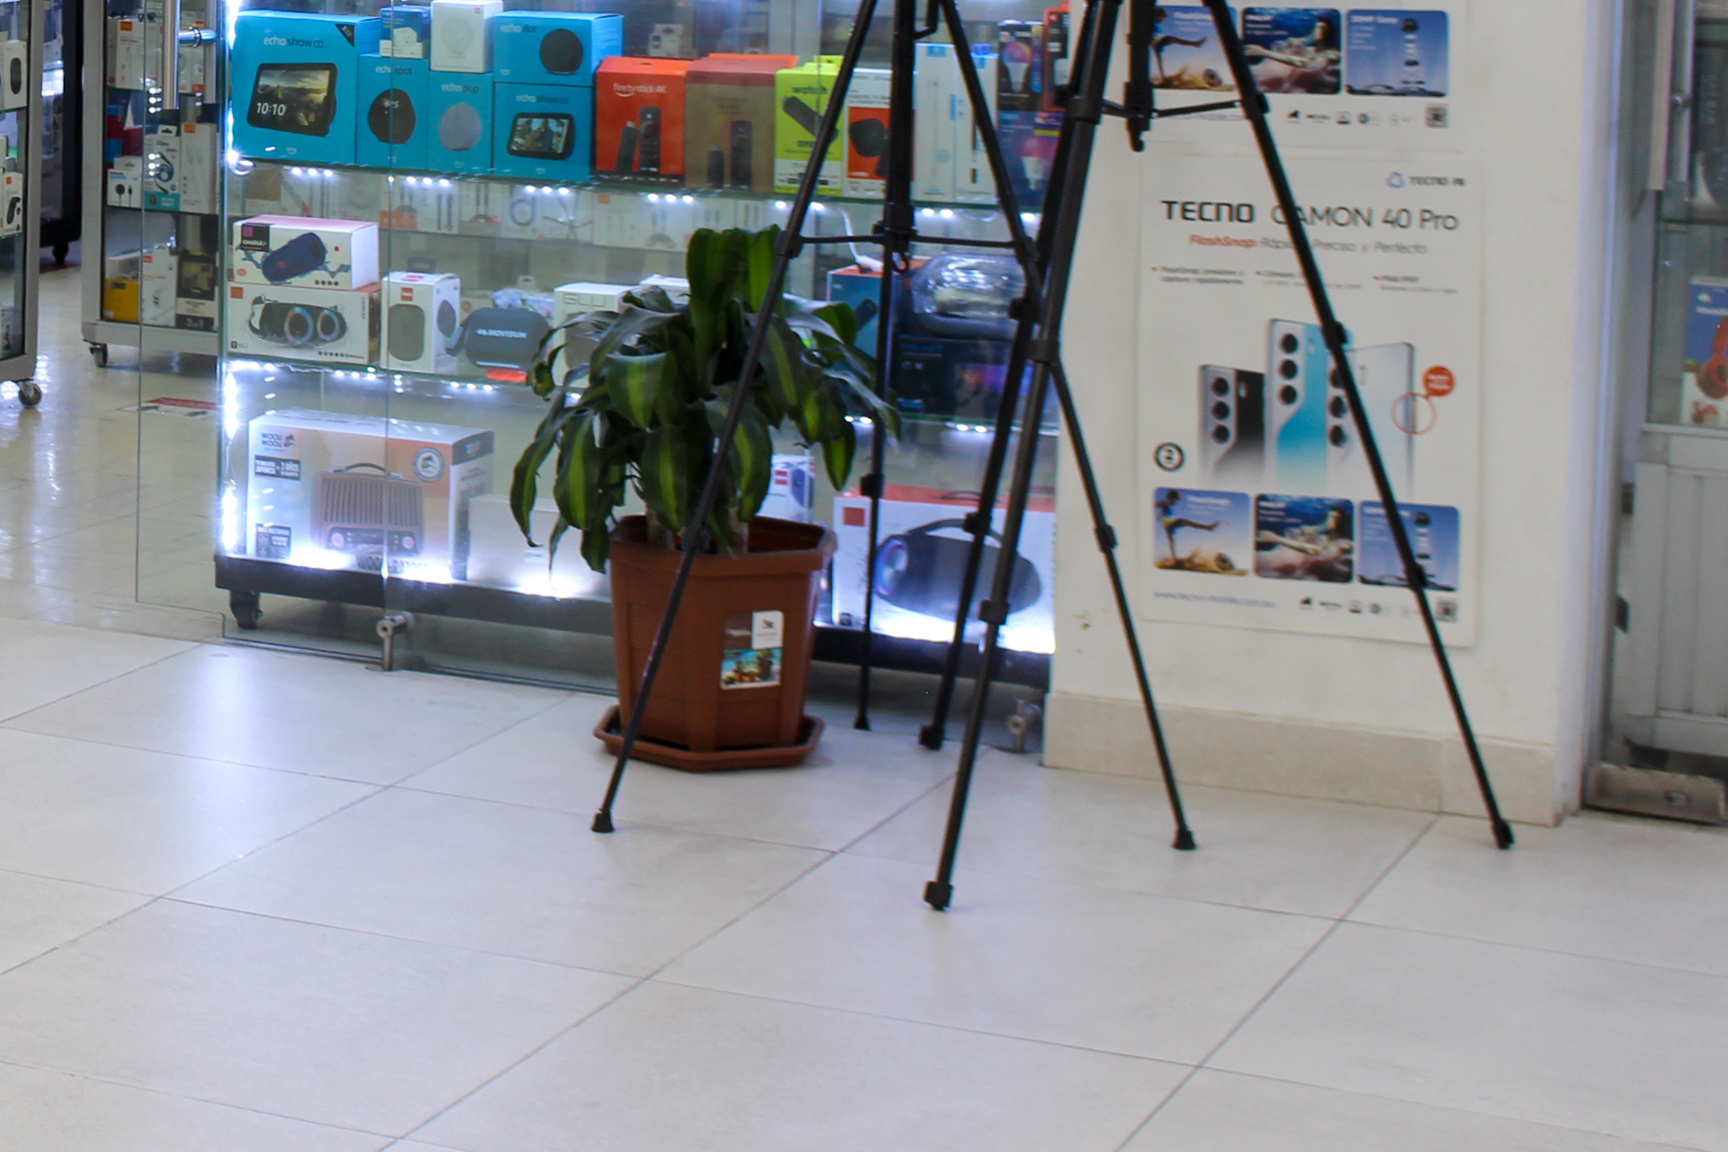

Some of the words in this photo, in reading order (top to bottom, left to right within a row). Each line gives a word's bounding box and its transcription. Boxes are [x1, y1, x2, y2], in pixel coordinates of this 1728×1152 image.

[264, 36, 286, 46] echo
[286, 37, 313, 47] show
[256, 102, 286, 116] 10:10
[1160, 200, 1256, 223] TECNO
[1271, 205, 1373, 228] CAMON
[1382, 208, 1412, 229] 40
[1419, 209, 1459, 231] Pro
